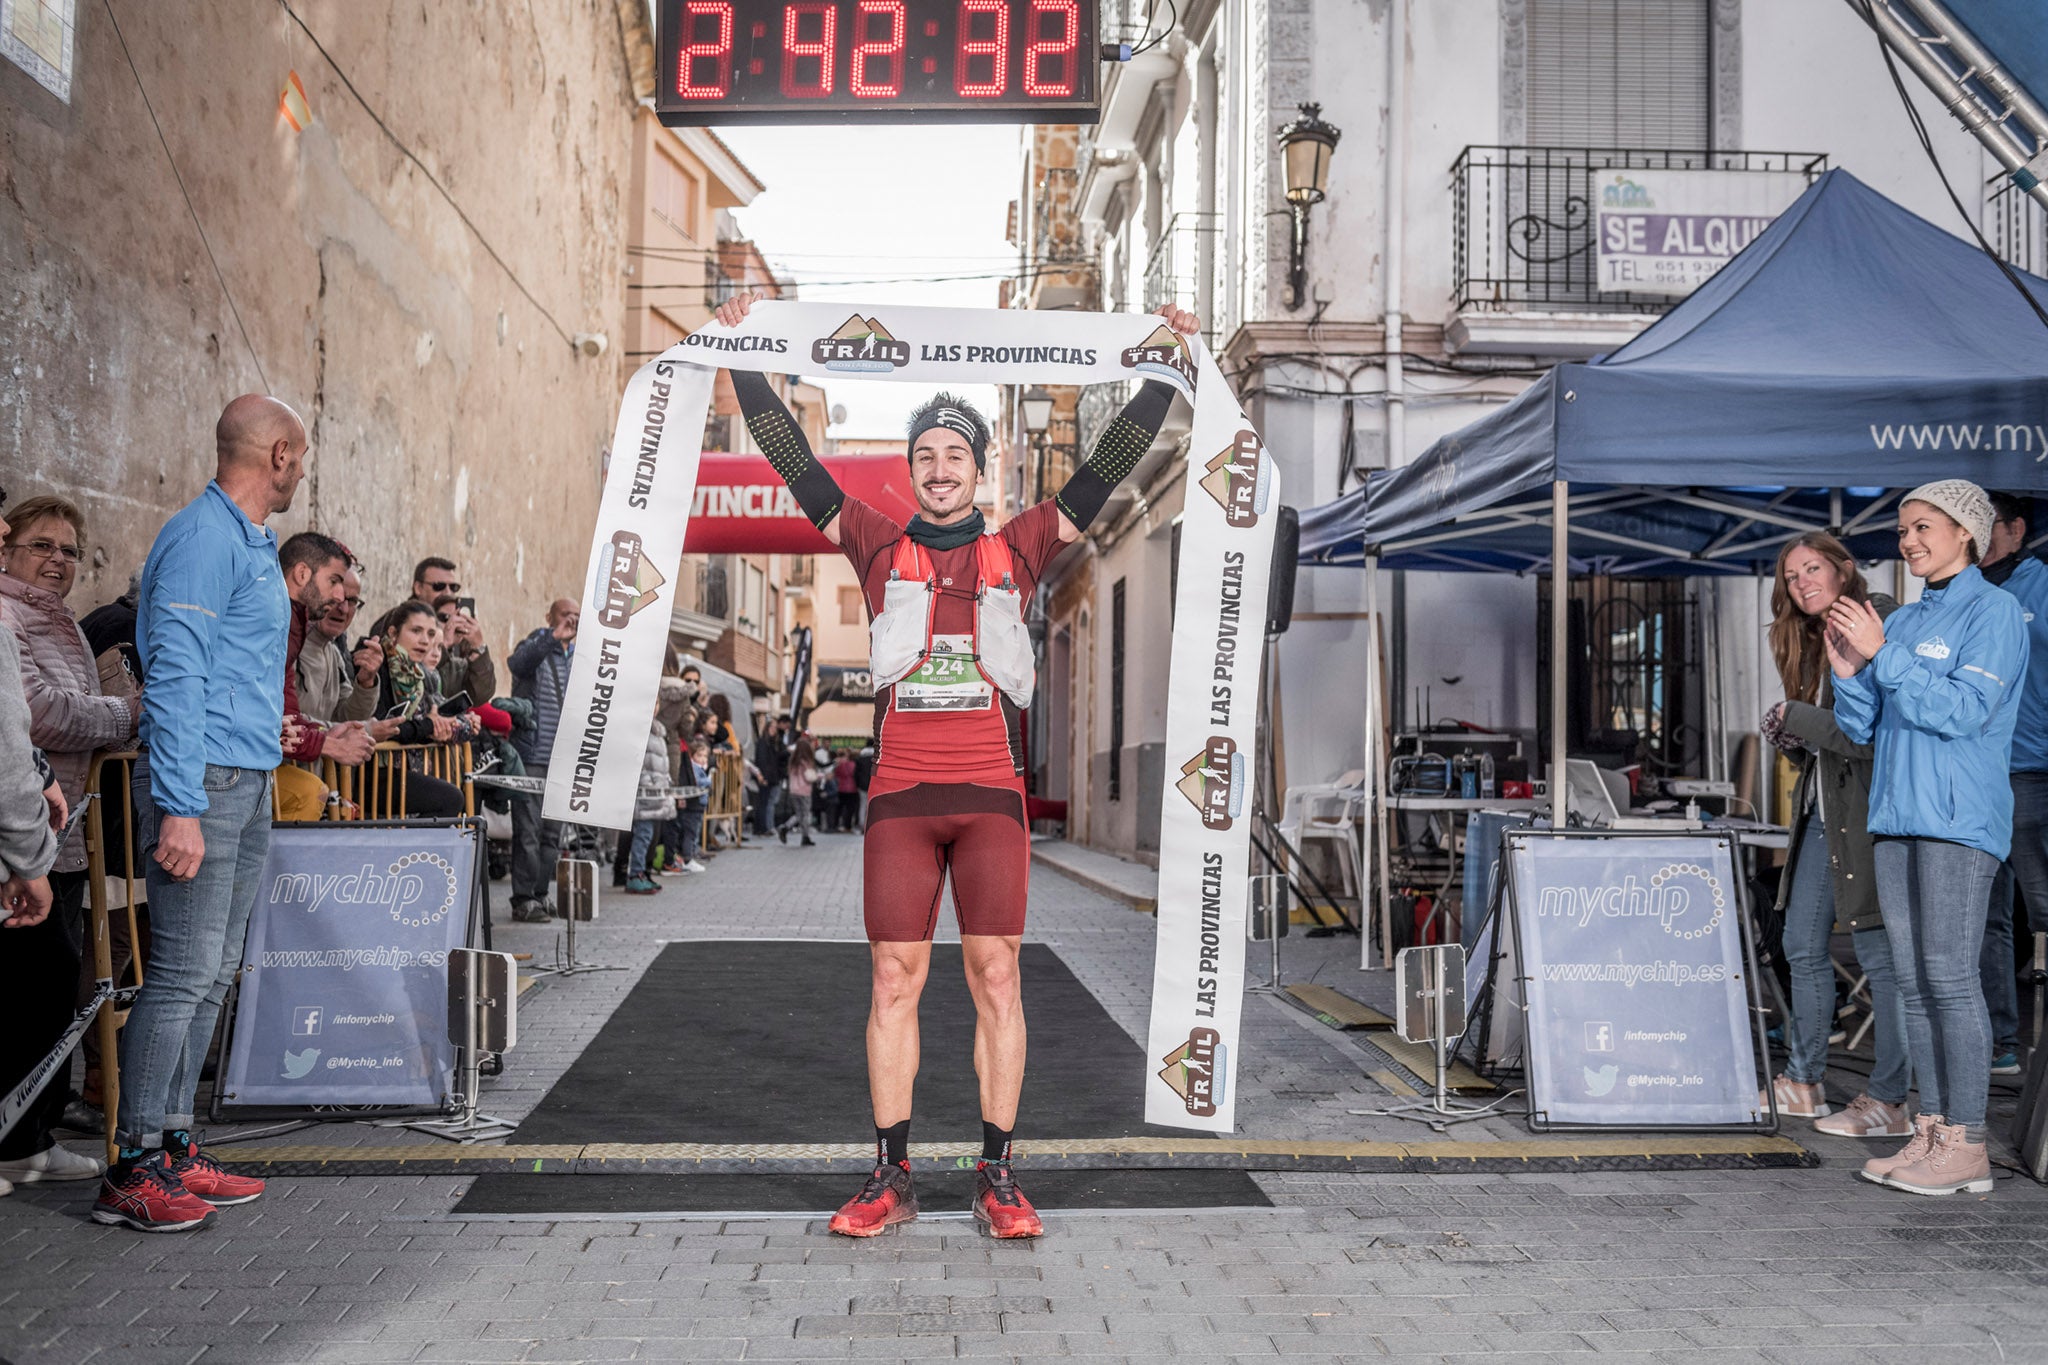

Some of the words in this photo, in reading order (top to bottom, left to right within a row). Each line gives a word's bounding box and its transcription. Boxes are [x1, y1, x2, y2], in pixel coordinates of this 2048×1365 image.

[1606, 216, 1647, 252] SE
[1662, 216, 1771, 257] ALQUI
[675, 333, 788, 354] OVINCIAS
[921, 345, 961, 362] LAS
[966, 346, 1097, 366] PROVINCIAS
[628, 380, 671, 510] PROVINCIAS
[690, 484, 808, 518] VINCIA
[1214, 551, 1244, 682] PROVINCIAS
[598, 638, 621, 681] LAS
[921, 656, 965, 676] 524
[842, 671, 871, 688] PO
[1211, 685, 1231, 727] LAS
[569, 682, 615, 813] PROVINCIAS
[269, 863, 424, 914] mychip
[1538, 875, 1690, 928] mychip
[1199, 852, 1223, 974] PROVINCIAS
[262, 945, 447, 970] www.mychip.es
[1541, 960, 1727, 987] www.mychip.es
[1195, 977, 1217, 1018] LAS
[332, 1013, 395, 1025] /infomychip
[1624, 1030, 1687, 1042] /infomychip
[327, 1056, 404, 1070] @Mychip_Info
[1627, 1074, 1704, 1088] @Mychip_Info
